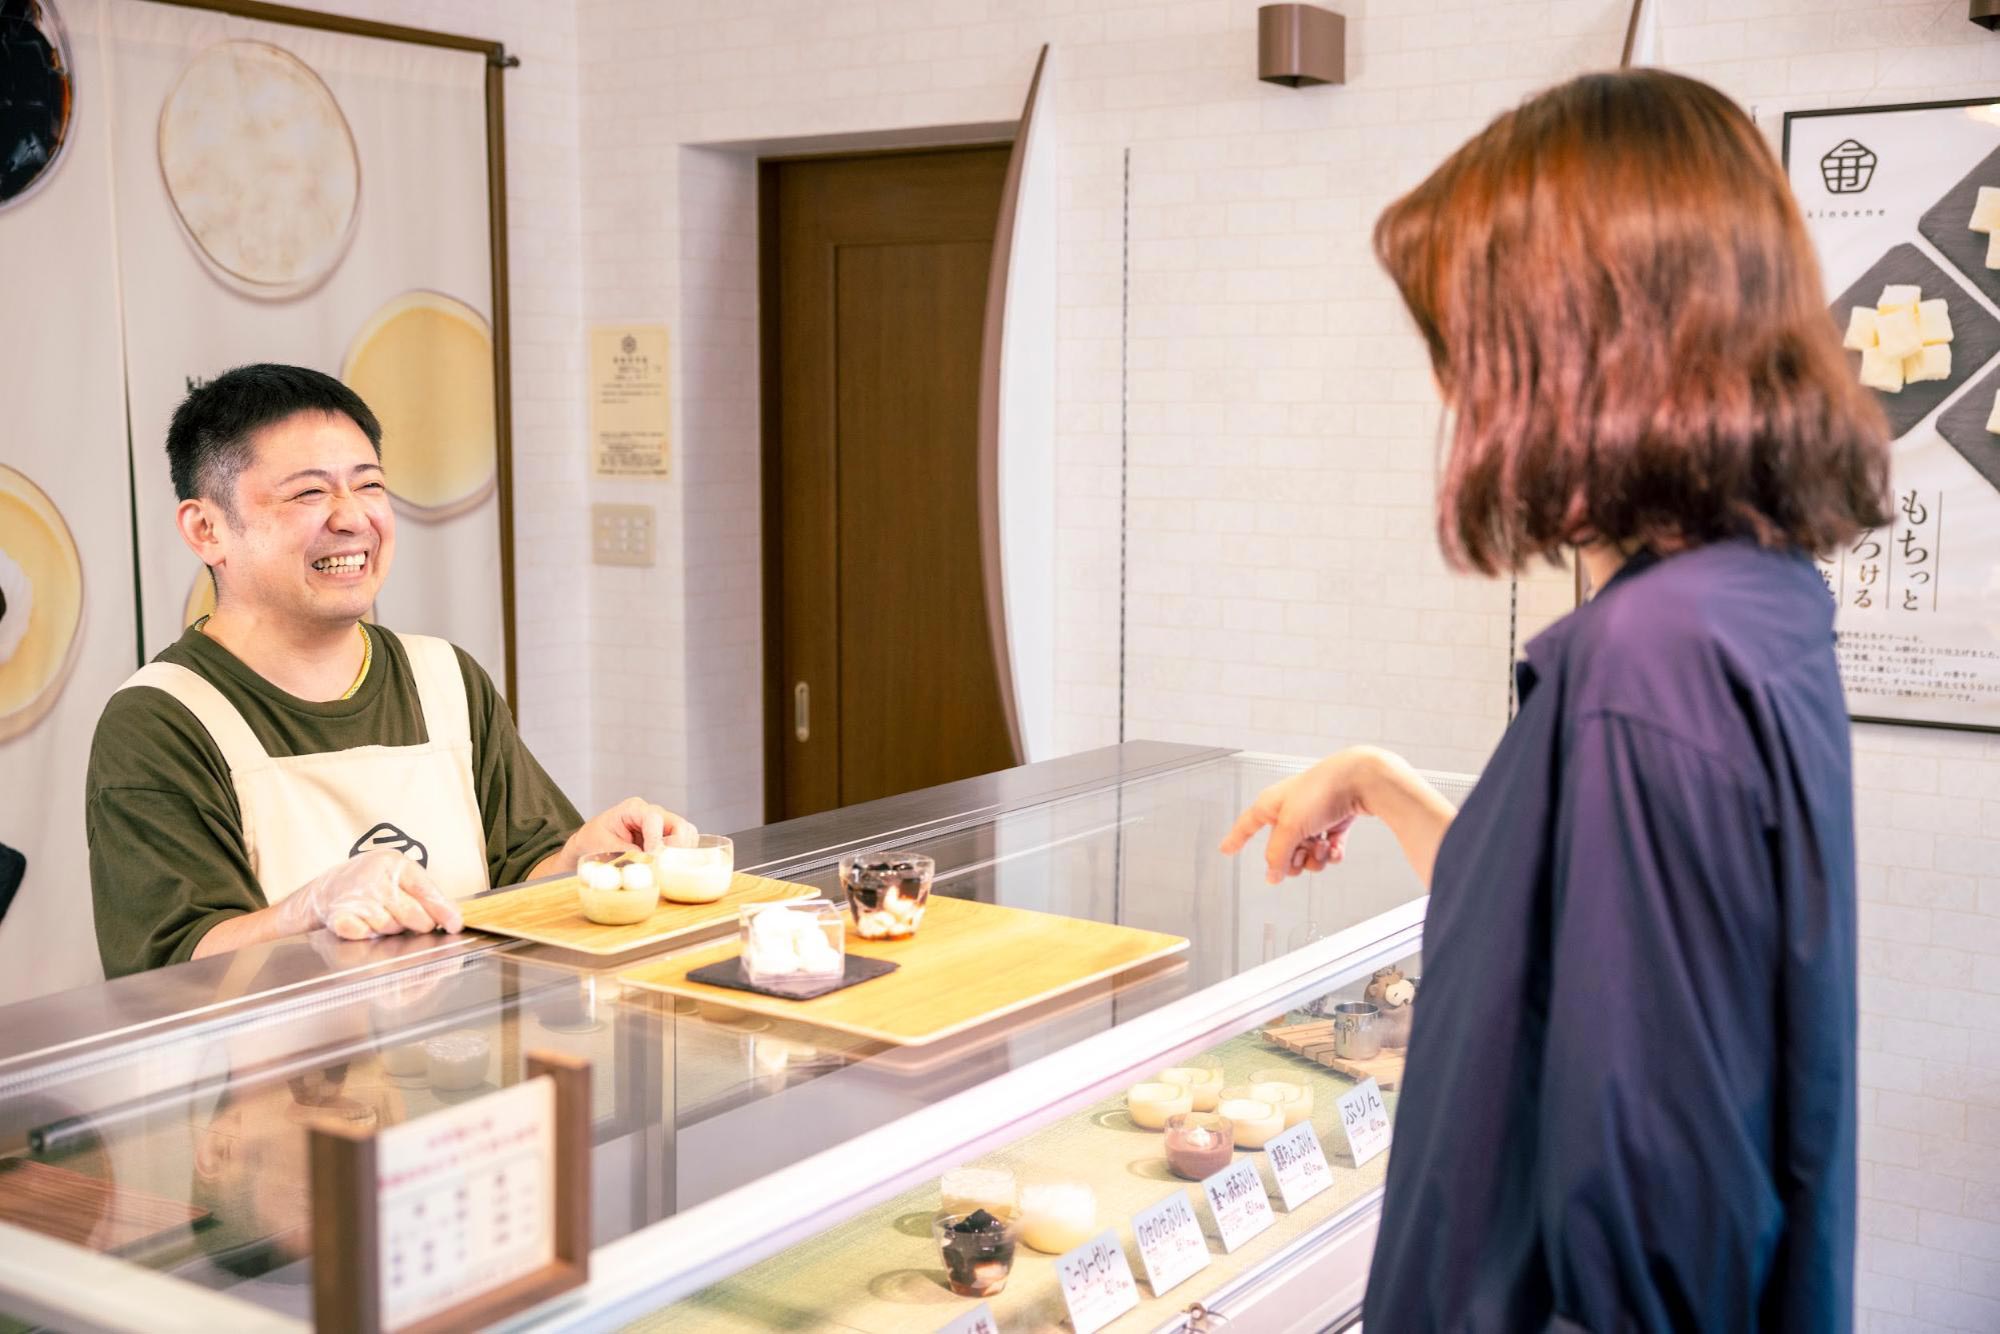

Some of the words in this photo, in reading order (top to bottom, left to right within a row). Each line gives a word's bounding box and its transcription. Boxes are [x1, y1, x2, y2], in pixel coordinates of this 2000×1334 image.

[1807, 207, 1885, 218] kinoene
[1897, 490, 1930, 611] もちっと
